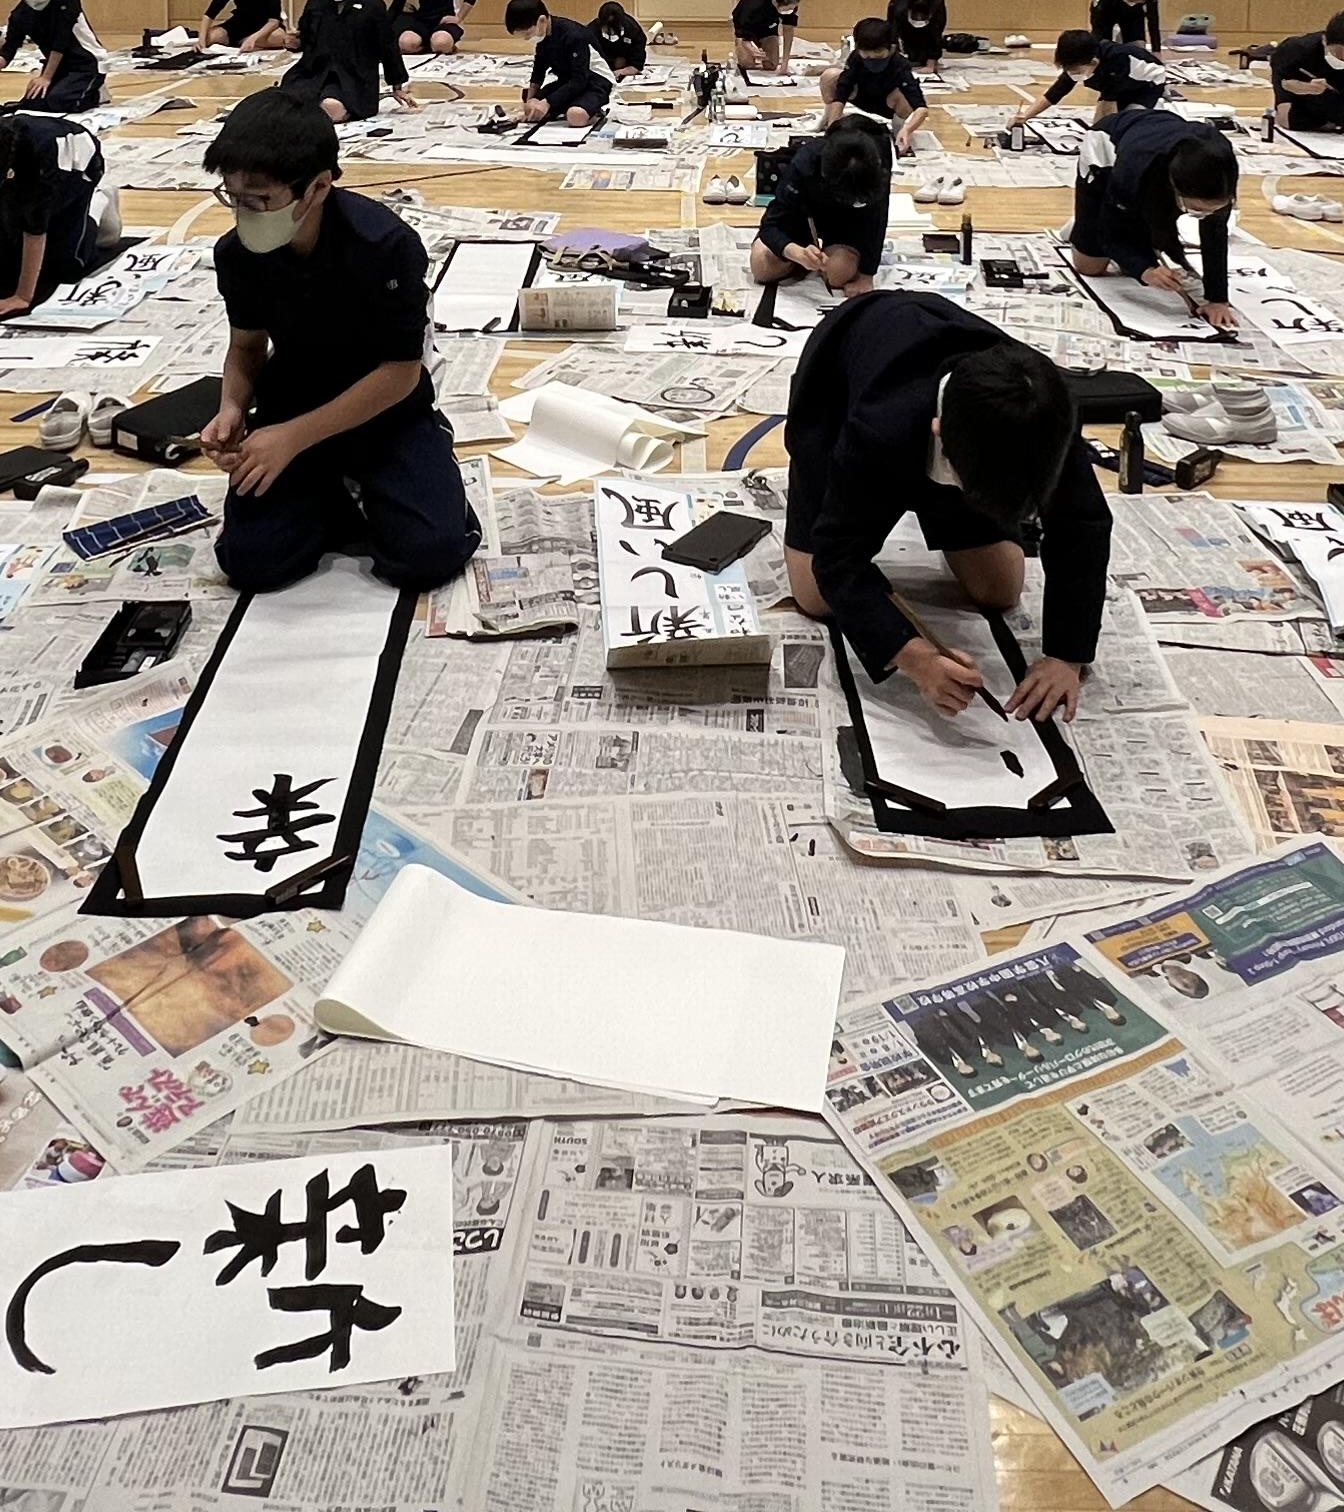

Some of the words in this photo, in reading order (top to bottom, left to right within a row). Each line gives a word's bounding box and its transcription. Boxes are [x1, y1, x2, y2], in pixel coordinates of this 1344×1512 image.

[761, 1322, 961, 1359] 心不全と向き合うために
